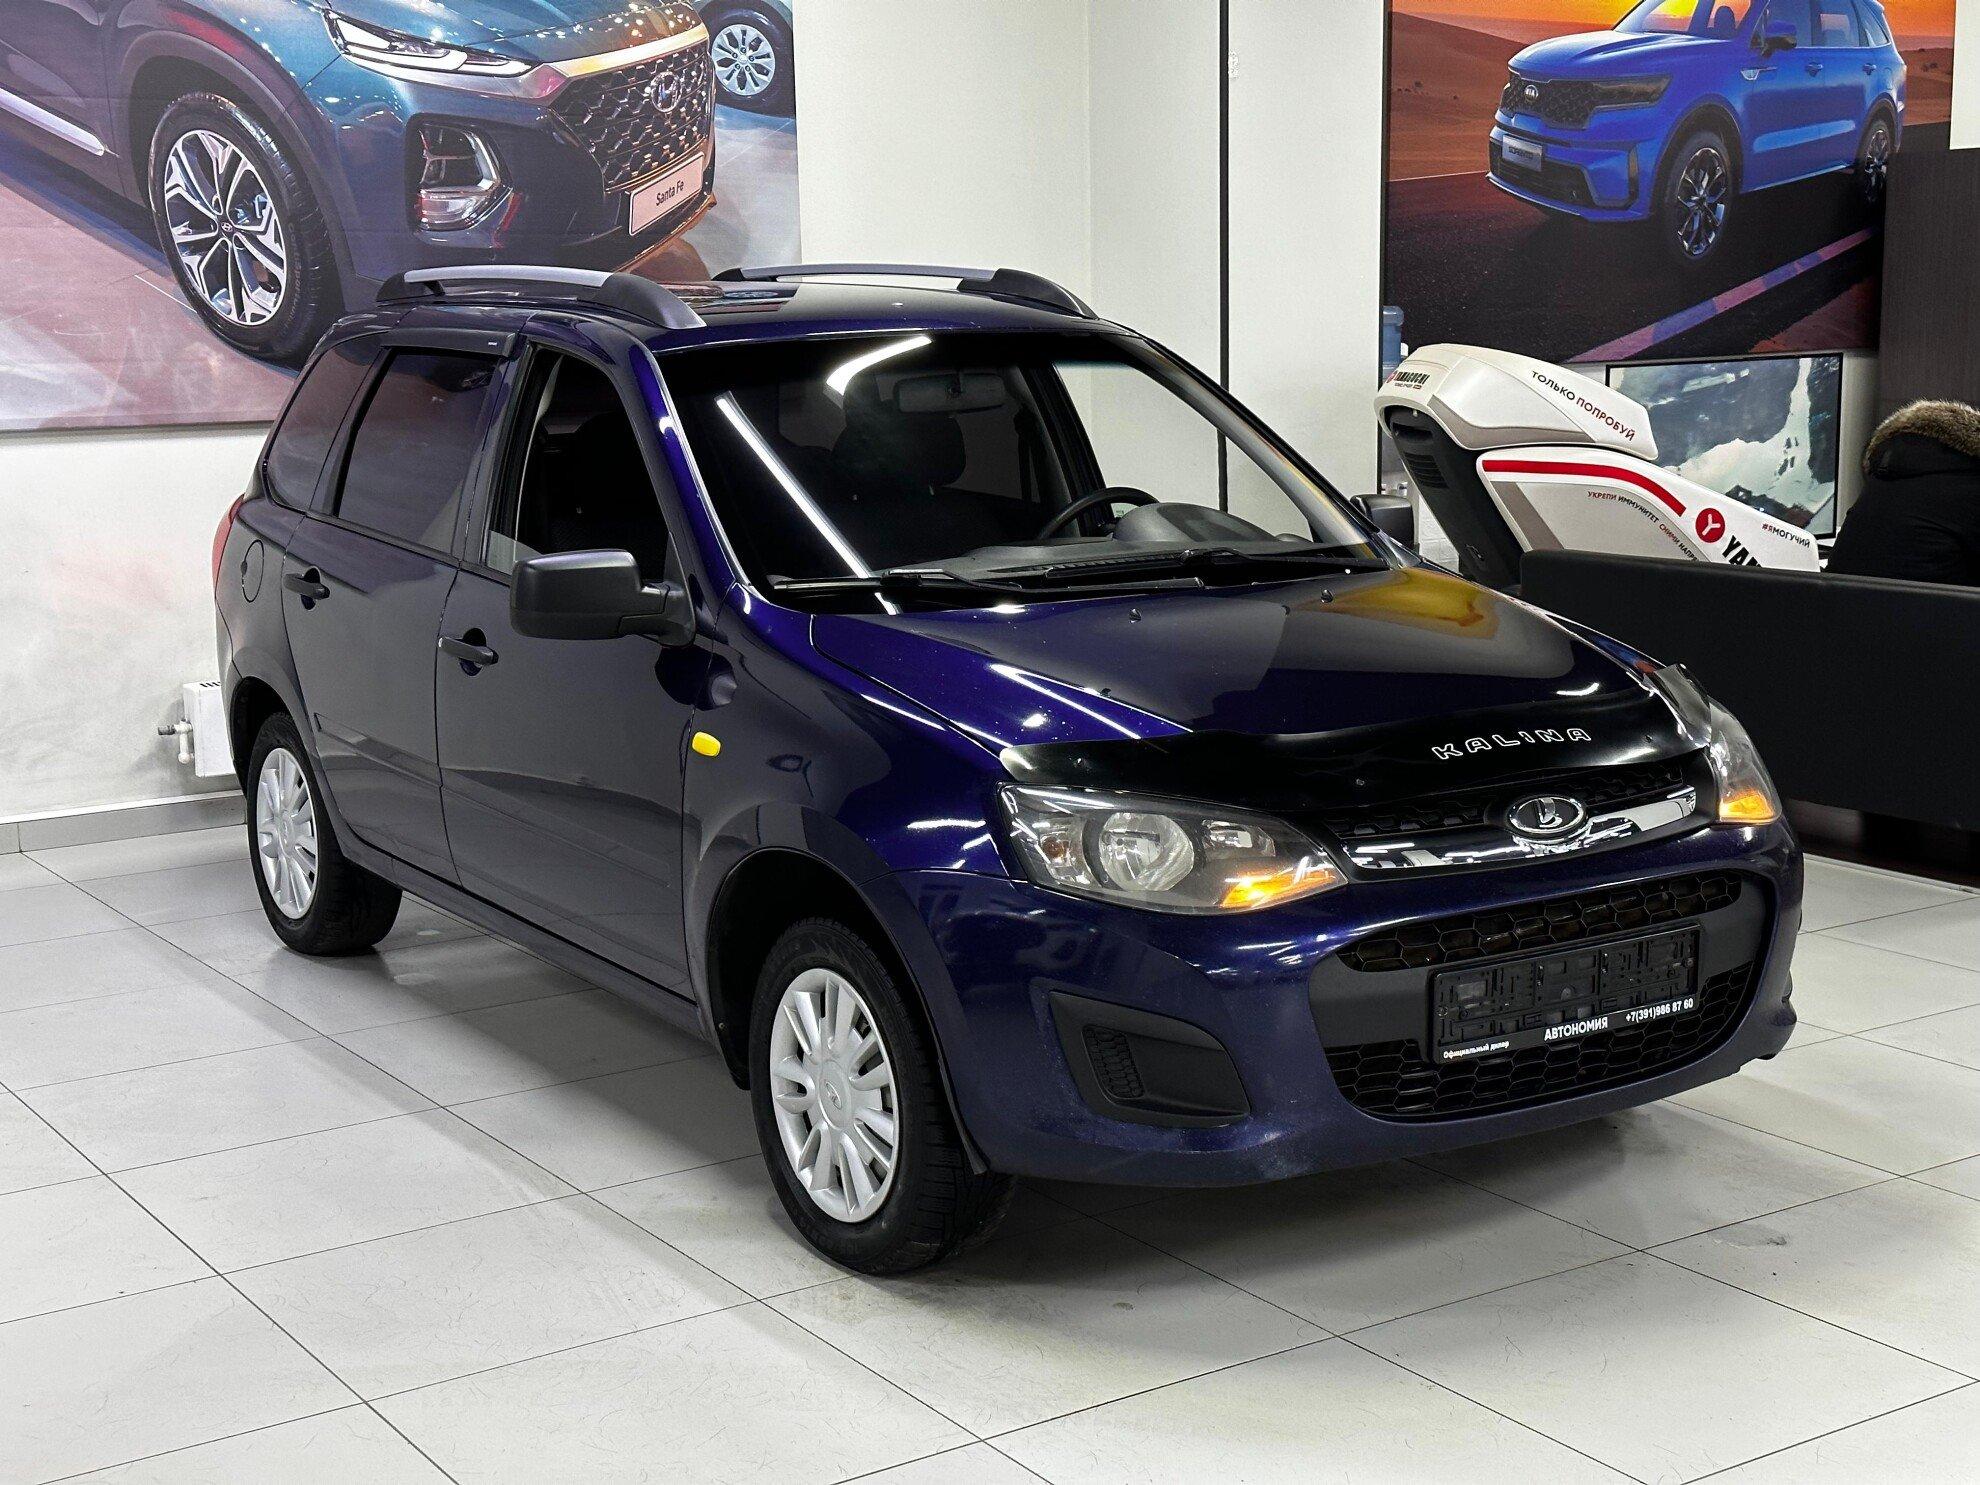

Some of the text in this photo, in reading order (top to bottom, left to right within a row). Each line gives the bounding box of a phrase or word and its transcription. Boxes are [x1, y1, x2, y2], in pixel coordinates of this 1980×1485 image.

[656, 180, 685, 206] Santa Fe
[1531, 370, 1636, 442] ТОЛЬКО ПОПРОБУЙ
[1587, 491, 1617, 500] УКРЕПИ
[1618, 495, 1660, 523] ИММУНИТЕТ
[1659, 523, 1680, 544] СНИМИ
[1762, 522, 1811, 549] #ЯМОГУЧИЙ
[1431, 728, 1592, 760] KALINA
[1625, 997, 1694, 1024] +7(391)986 87 60
[1544, 1016, 1609, 1042] АВТОНОМИЯ
[1443, 1043, 1490, 1060] Официальный
